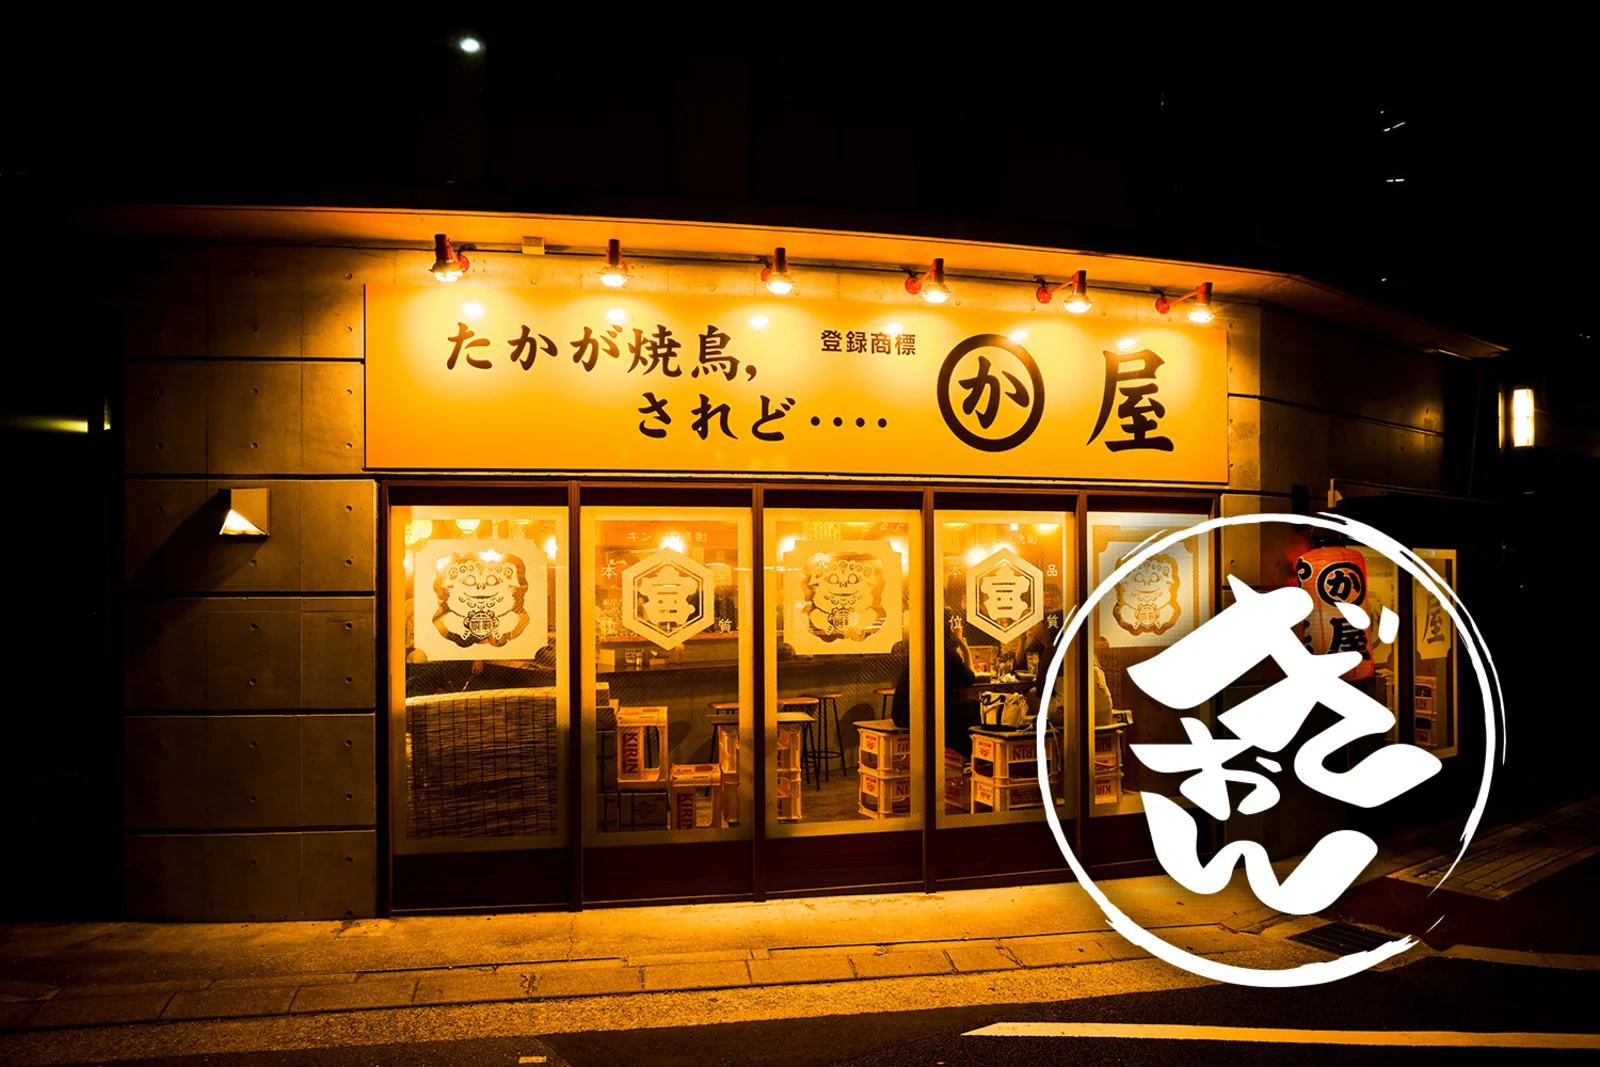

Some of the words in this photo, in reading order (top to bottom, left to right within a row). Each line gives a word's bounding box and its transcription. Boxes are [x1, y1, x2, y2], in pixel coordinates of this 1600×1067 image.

[820, 329, 917, 356] 登録商標
[627, 732, 639, 774] KIRIN
[1013, 747, 1037, 760] IRIN
[1096, 784, 1112, 796] KIR
